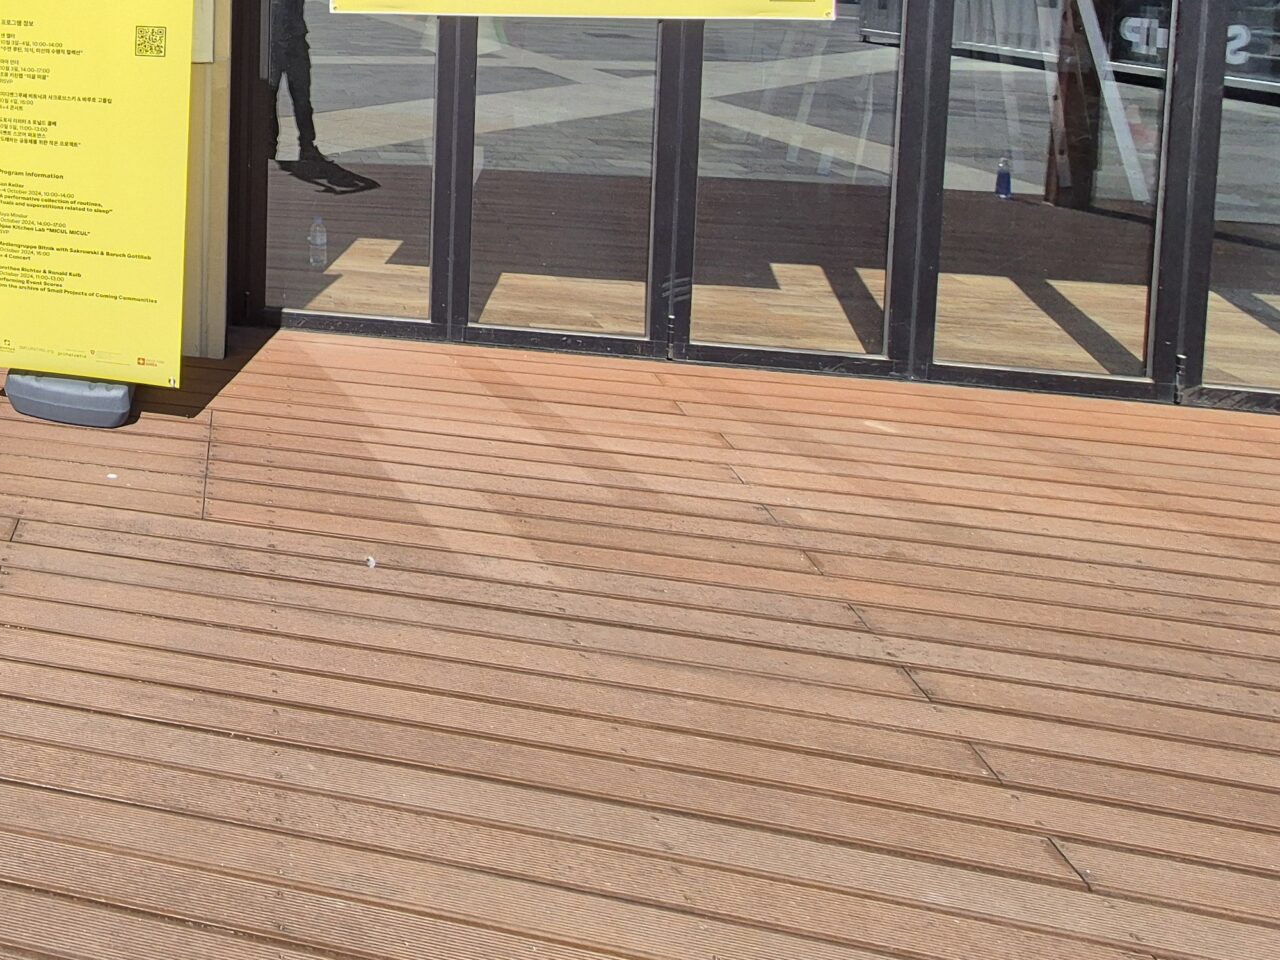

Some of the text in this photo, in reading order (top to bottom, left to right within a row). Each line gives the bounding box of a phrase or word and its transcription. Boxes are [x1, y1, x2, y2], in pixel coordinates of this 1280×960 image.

[25, 171, 64, 179] information
[4, 194, 40, 202] performative
[77, 200, 103, 208] routines,
[21, 248, 35, 256] 2024,
[8, 253, 31, 261] Concert
[63, 289, 87, 297] Projects
[95, 292, 118, 300] Coming
[118, 295, 158, 303] Communities
